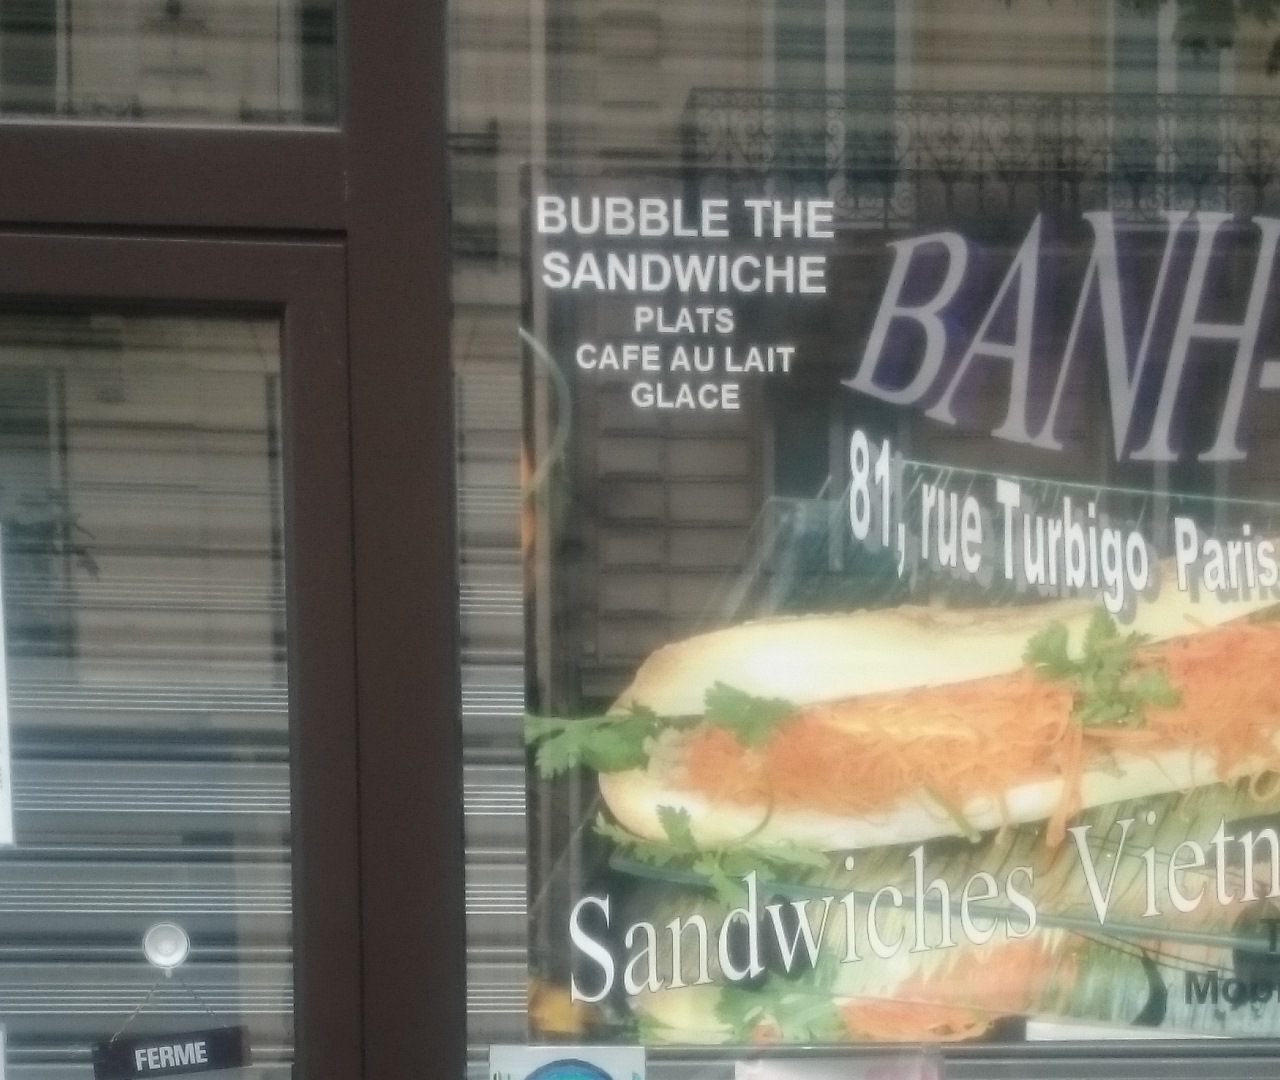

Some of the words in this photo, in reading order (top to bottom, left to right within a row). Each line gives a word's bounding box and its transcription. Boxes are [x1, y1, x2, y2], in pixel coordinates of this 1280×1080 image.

[536, 196, 729, 238] BUBBLE
[745, 198, 835, 239] THE
[542, 252, 827, 294] SANDWICHE
[634, 306, 735, 334] PLATS
[576, 343, 661, 371] CAFE
[671, 344, 716, 372] AU
[725, 345, 796, 373] LAIT
[631, 381, 741, 410] GLACE
[848, 429, 906, 578] 81,
[921, 481, 983, 574] rue
[995, 478, 1150, 614] Turbigo
[1174, 516, 1279, 593] Paris
[567, 845, 1039, 1005] Sandwiches
[134, 1041, 209, 1072] FERME
